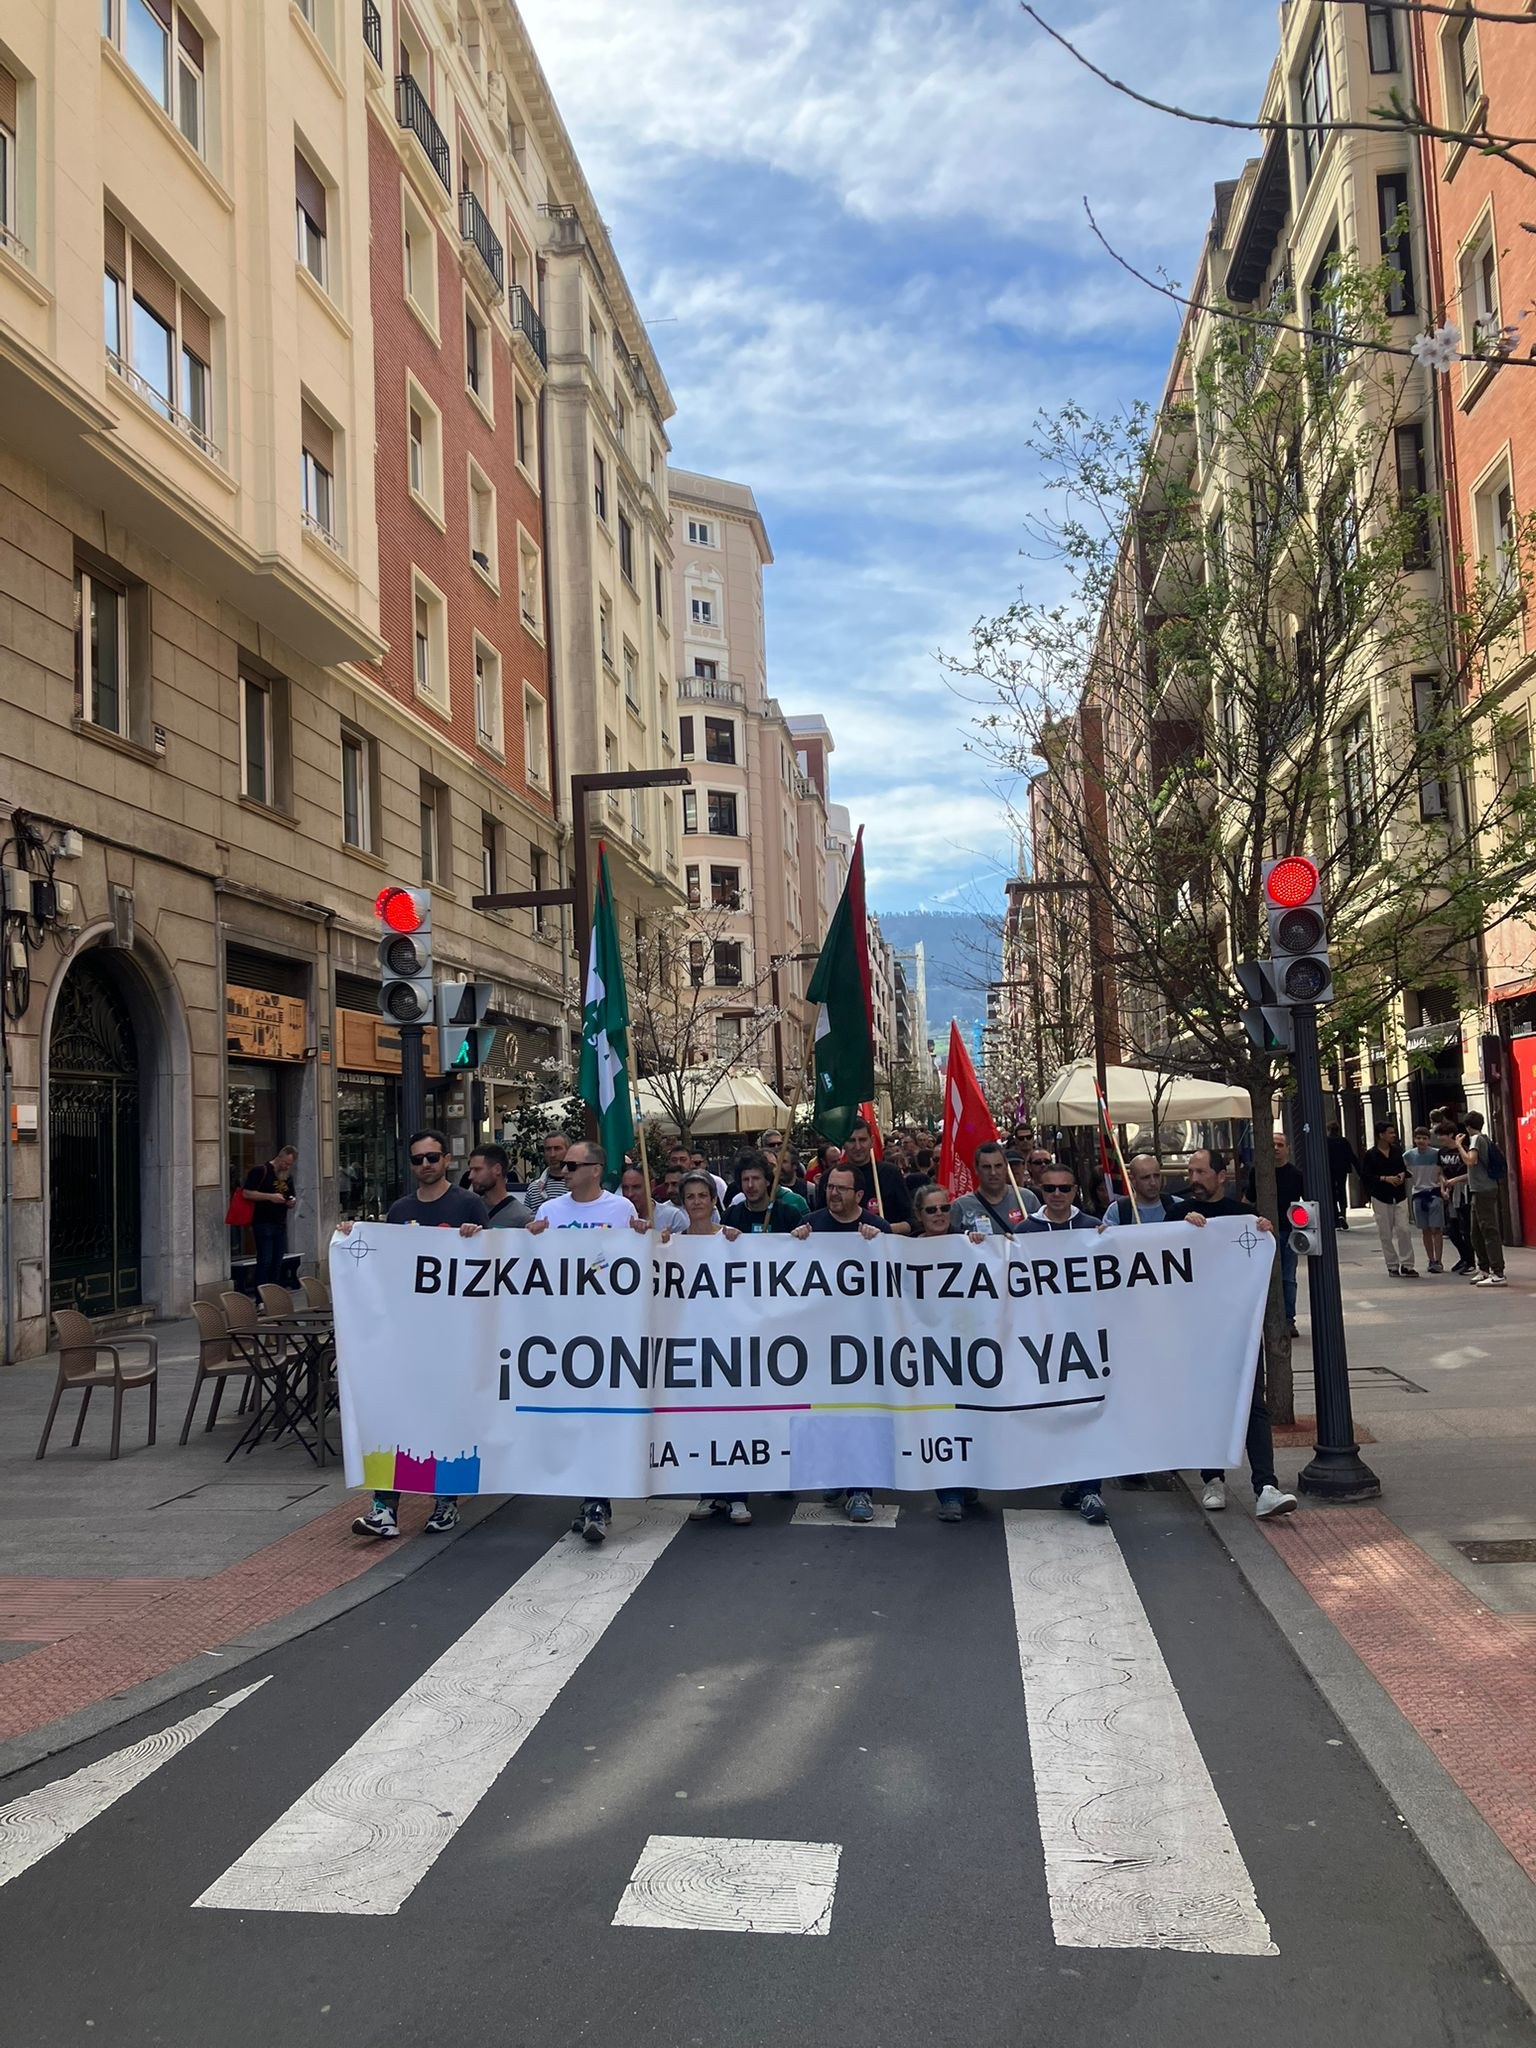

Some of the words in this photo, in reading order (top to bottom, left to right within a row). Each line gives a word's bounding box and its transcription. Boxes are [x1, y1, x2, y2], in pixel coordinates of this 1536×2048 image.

[415, 1255, 641, 1298] BIZKAIKO
[1007, 1247, 1194, 1298] GREBAN
[499, 1335, 808, 1400] ¡CONVENIO
[830, 1335, 1004, 1389] DIGNO
[1018, 1328, 1111, 1384] YA!
[649, 1441, 680, 1468] LA
[710, 1440, 771, 1467] LAB
[920, 1436, 973, 1464] UGT
